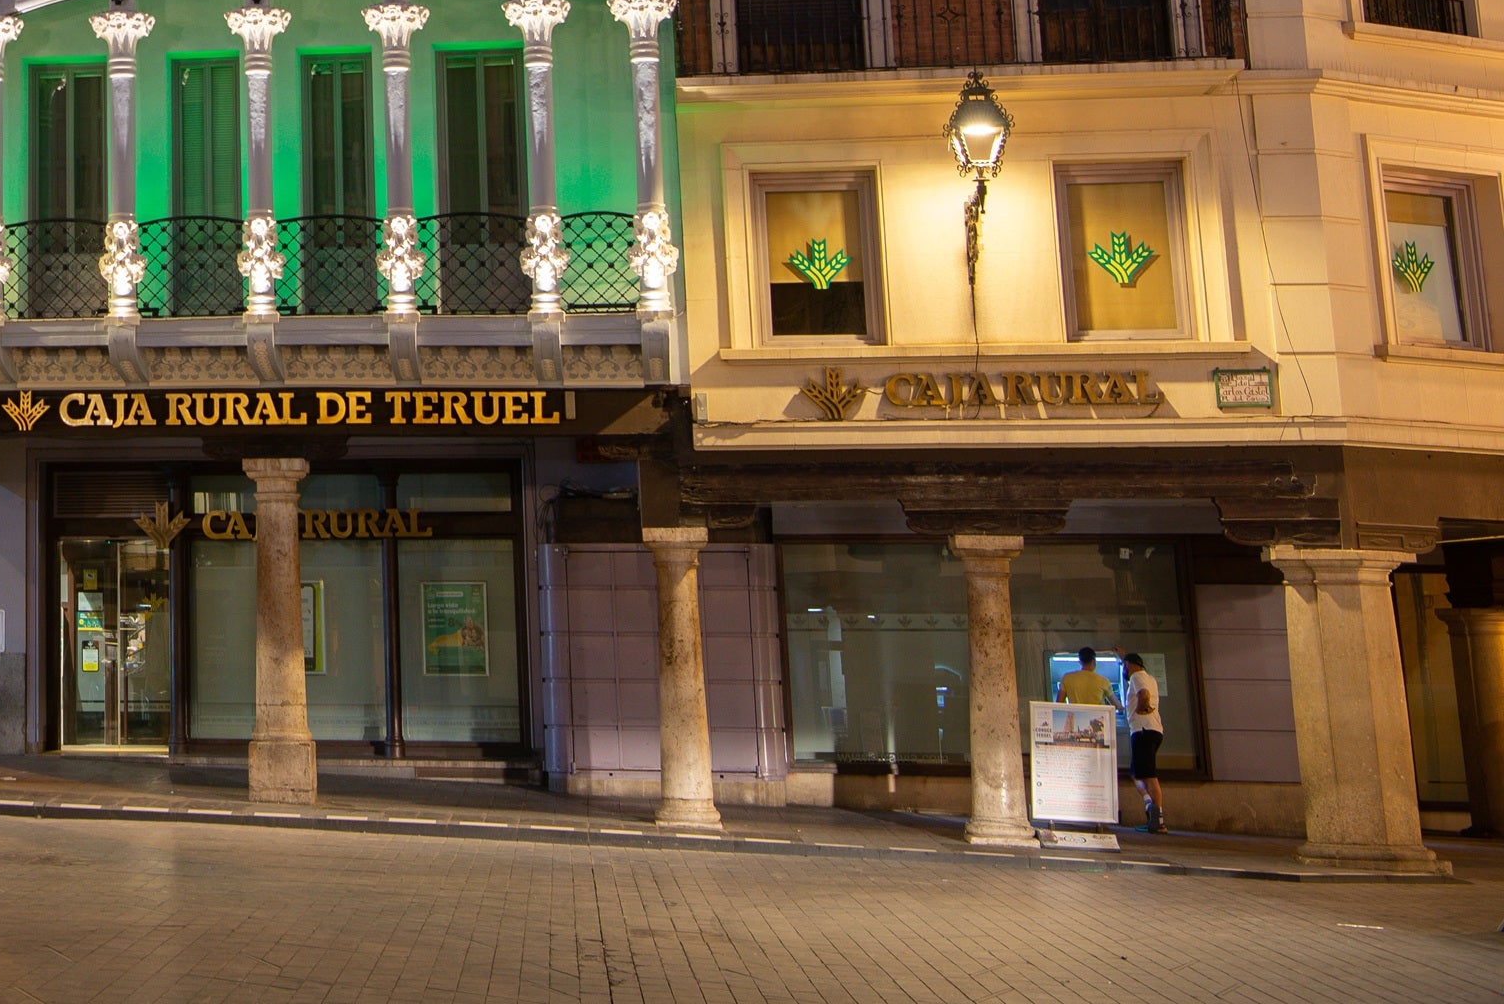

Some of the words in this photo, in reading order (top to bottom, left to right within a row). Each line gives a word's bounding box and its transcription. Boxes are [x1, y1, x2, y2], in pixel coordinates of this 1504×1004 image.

[885, 372, 997, 408] CAJA
[1001, 371, 1164, 405] RURAL
[59, 392, 156, 428] CAJA
[165, 392, 307, 426] RURAL
[316, 391, 372, 425] DE
[385, 391, 560, 425] TERUEL
[202, 510, 258, 542] CA
[300, 508, 433, 539] RURAL
